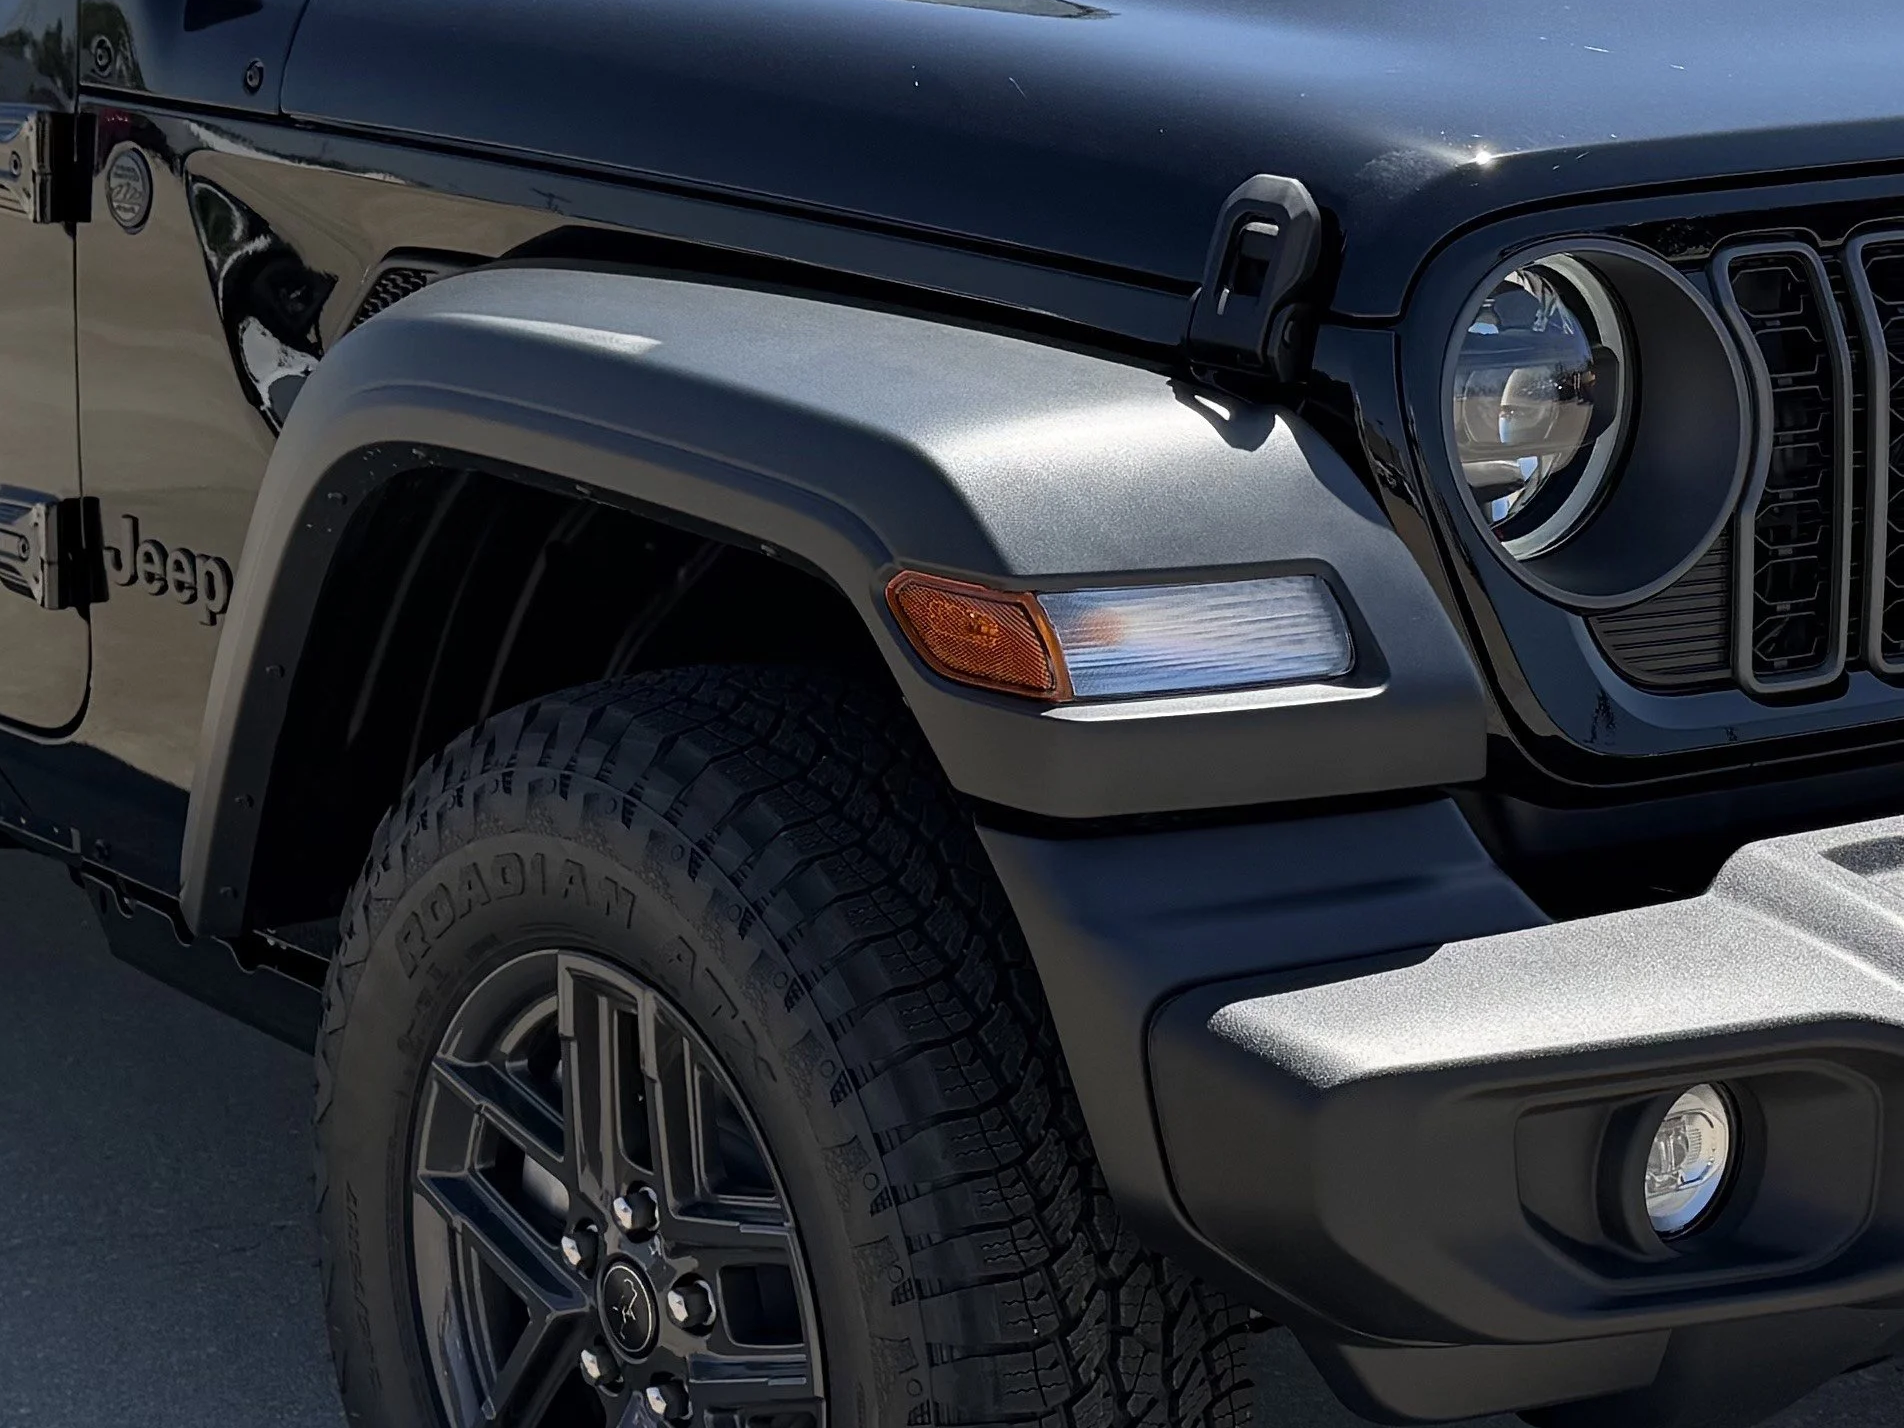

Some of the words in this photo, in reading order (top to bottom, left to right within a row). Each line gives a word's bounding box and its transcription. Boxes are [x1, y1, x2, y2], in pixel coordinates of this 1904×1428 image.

[102, 513, 234, 627] Jeep
[394, 851, 638, 979] ROADIAN
[658, 934, 778, 1083] ATX
